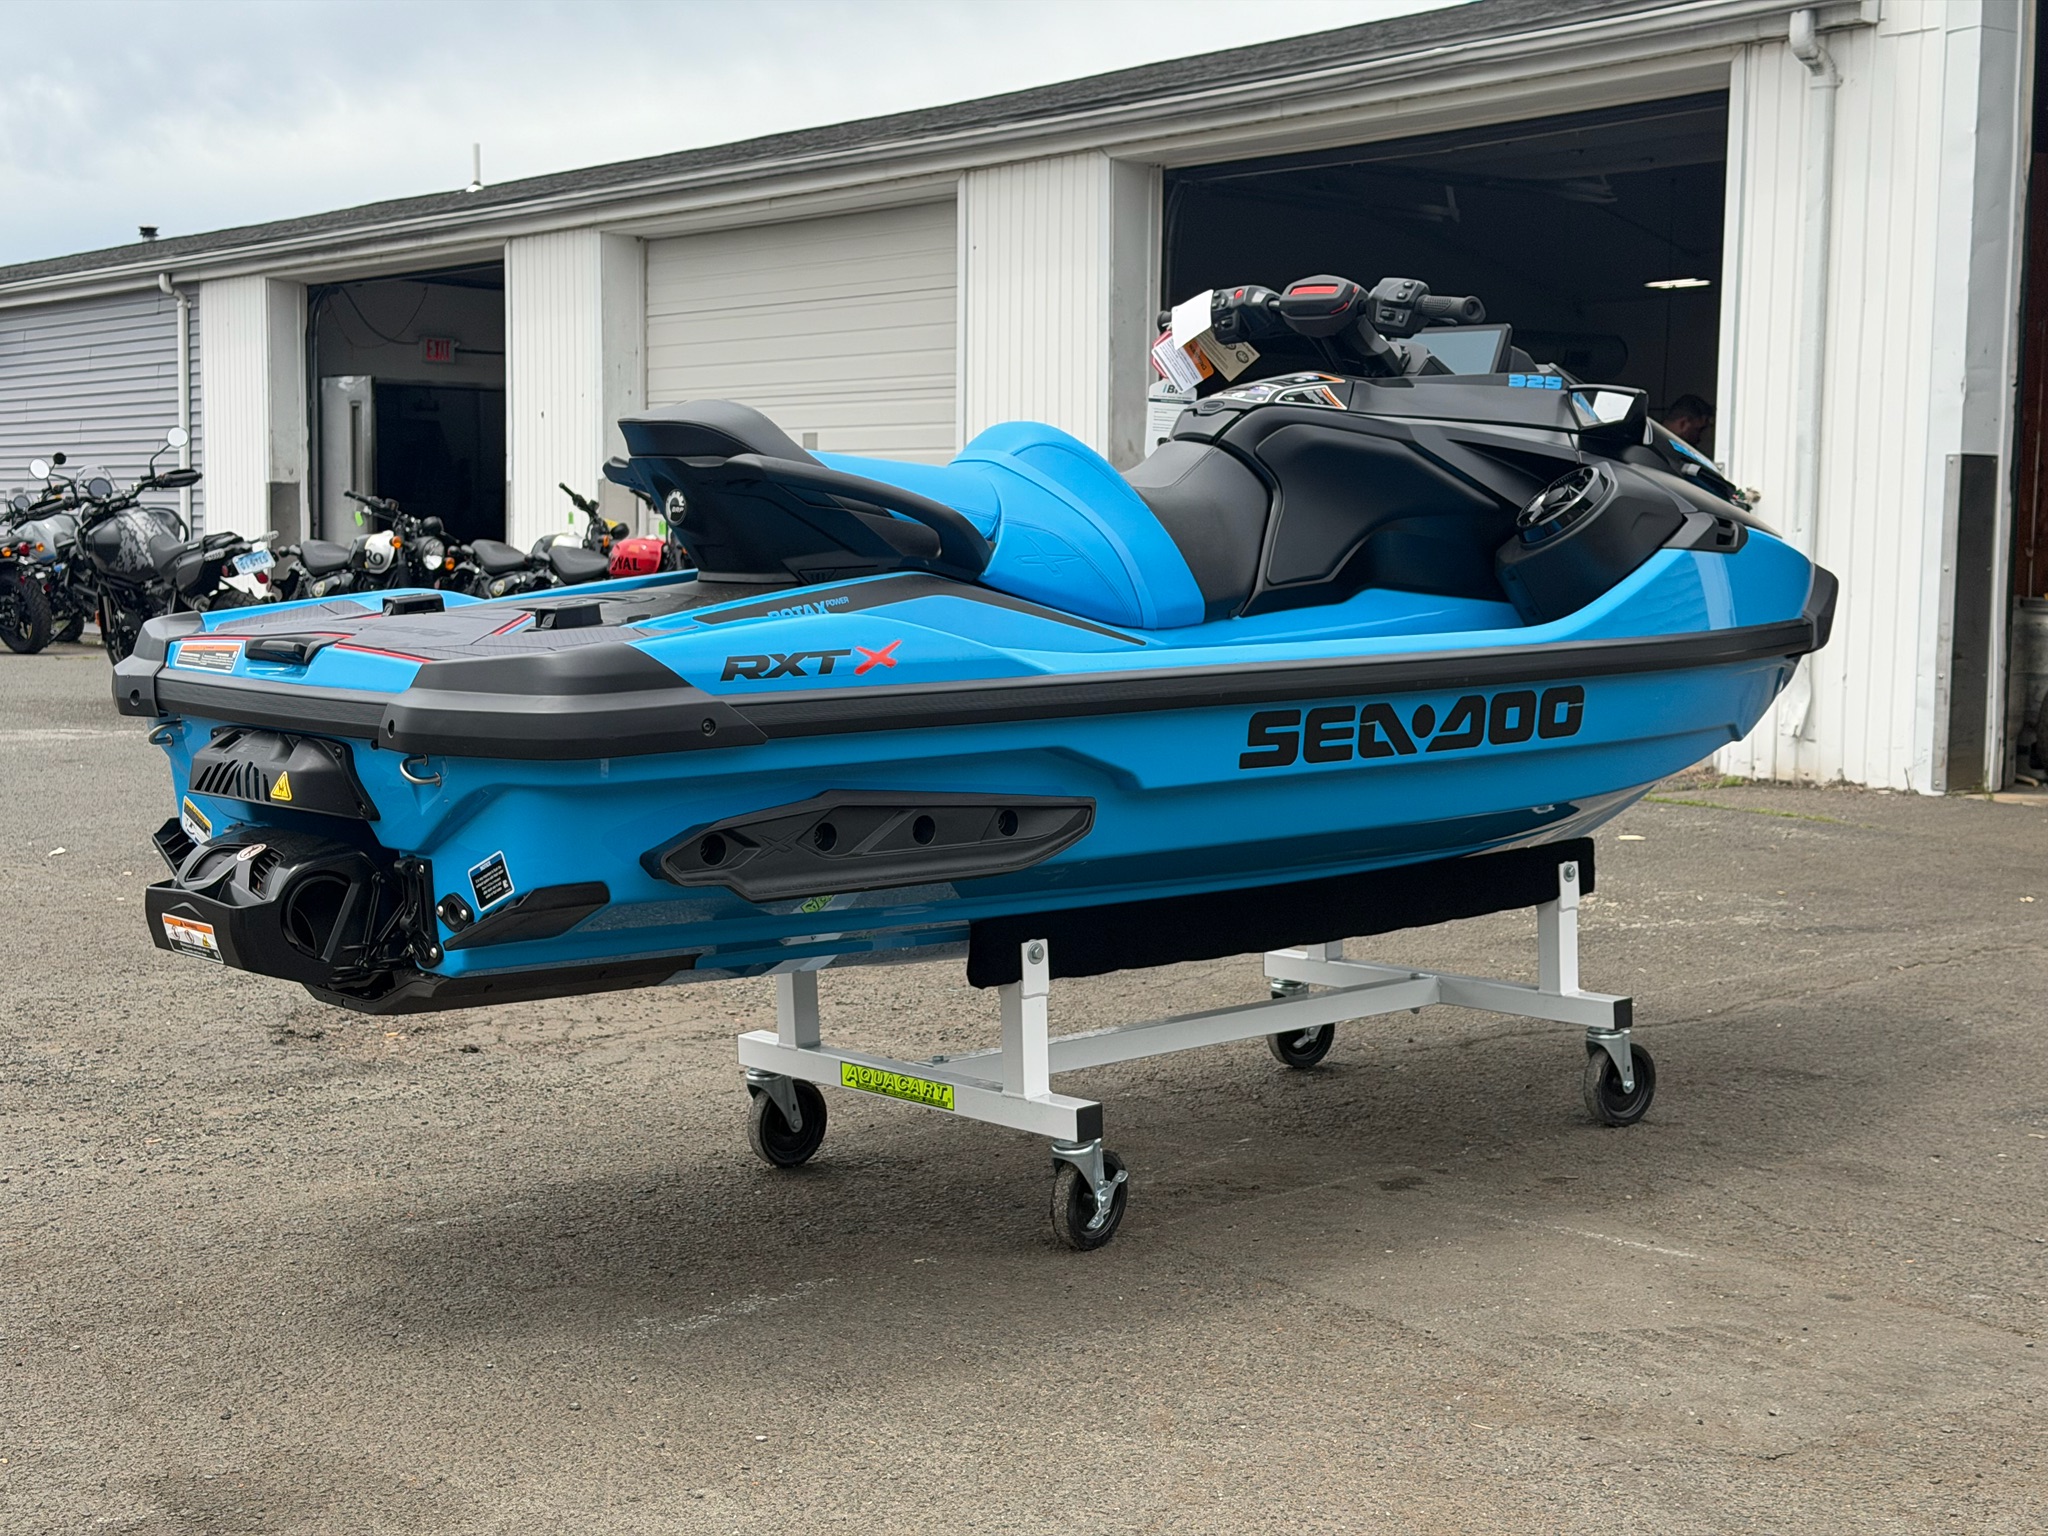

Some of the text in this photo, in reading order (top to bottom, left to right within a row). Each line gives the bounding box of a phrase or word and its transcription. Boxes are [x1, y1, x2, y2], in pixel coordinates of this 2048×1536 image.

[1508, 373, 1563, 390] 325
[825, 596, 850, 608] POWER
[719, 639, 903, 682] RXT X
[845, 1064, 950, 1101] AQUACART
